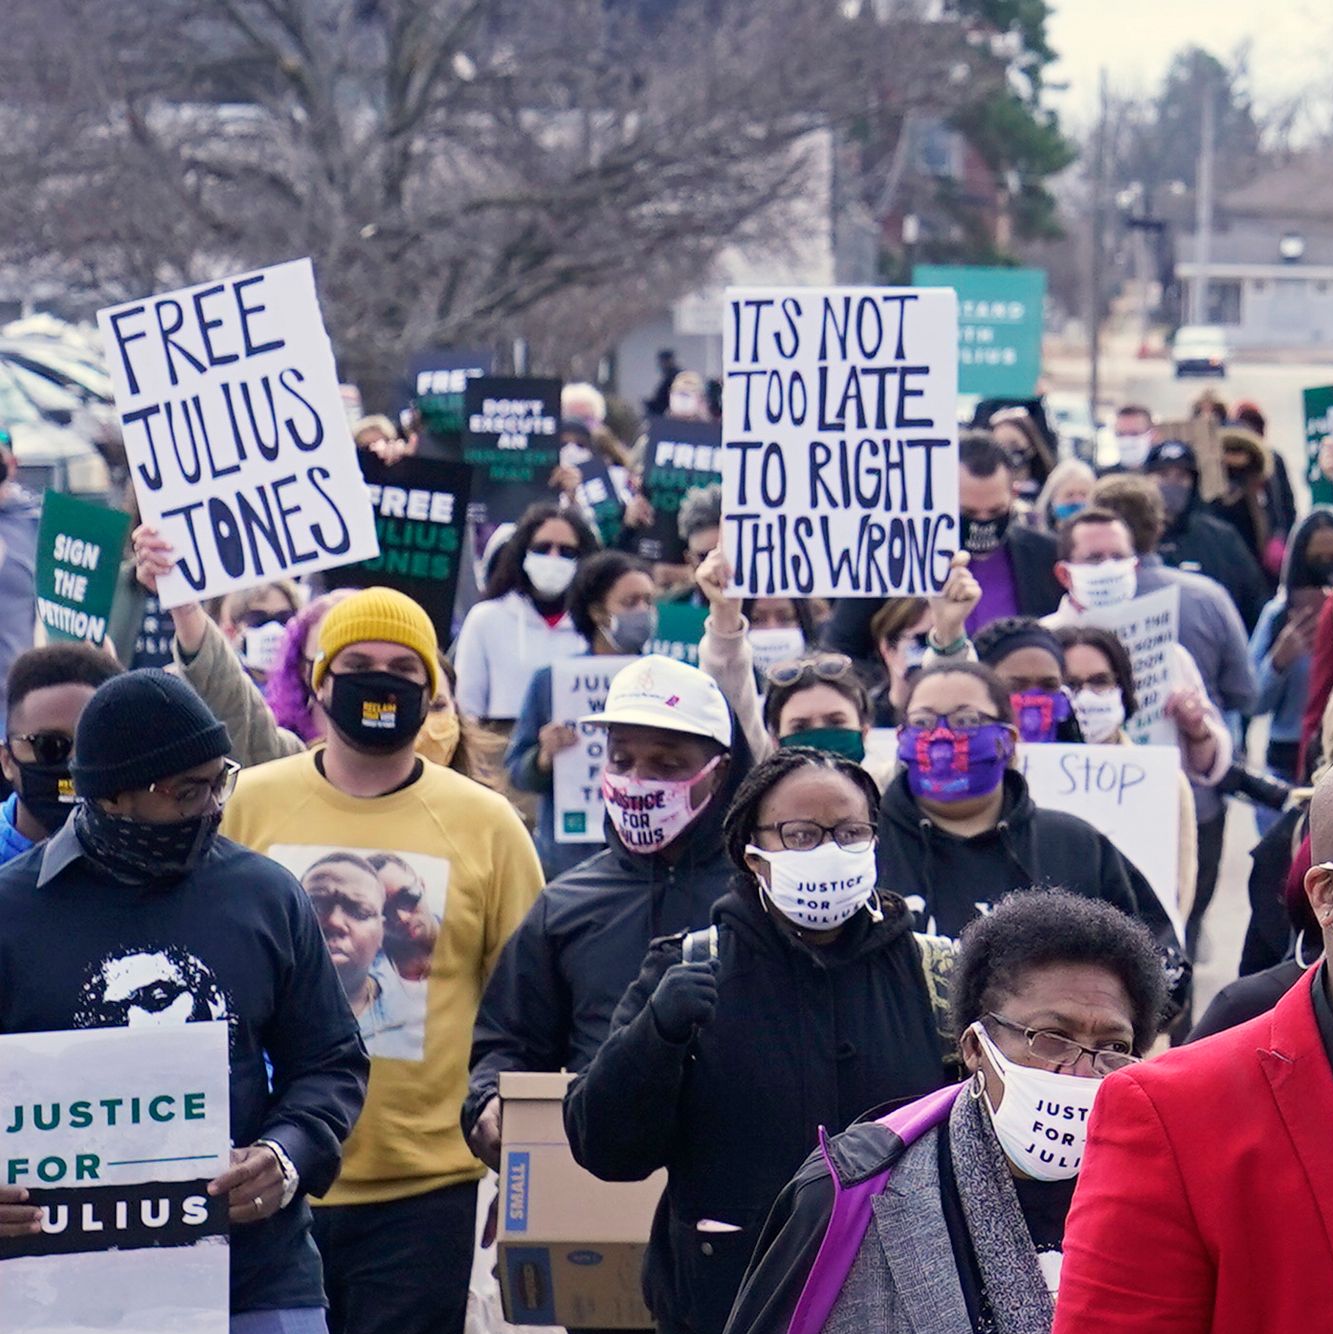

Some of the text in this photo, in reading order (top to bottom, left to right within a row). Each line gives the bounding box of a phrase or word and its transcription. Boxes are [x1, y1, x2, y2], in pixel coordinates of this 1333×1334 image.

[109, 275, 285, 395] FREE
[818, 295, 918, 361] NOT
[728, 366, 934, 432] TOO LATE
[122, 367, 325, 491] JULIUS
[726, 438, 951, 512] TO RIGHT
[161, 466, 351, 592] JONES
[378, 519, 459, 552] LIUS
[53, 533, 101, 571] SIGN
[725, 513, 955, 595] THIS WRONG
[54, 568, 89, 603] THE
[1059, 752, 1147, 804] Stop
[621, 812, 651, 830] FOR
[6, 1092, 206, 1133] JUSTICE
[1036, 1098, 1090, 1122] JUST
[1031, 1120, 1076, 1147] FOR
[7, 1153, 101, 1185] FOR
[1024, 1143, 1082, 1169] JULI
[510, 1162, 526, 1221] SMALL
[40, 1195, 209, 1235] ULIUS
